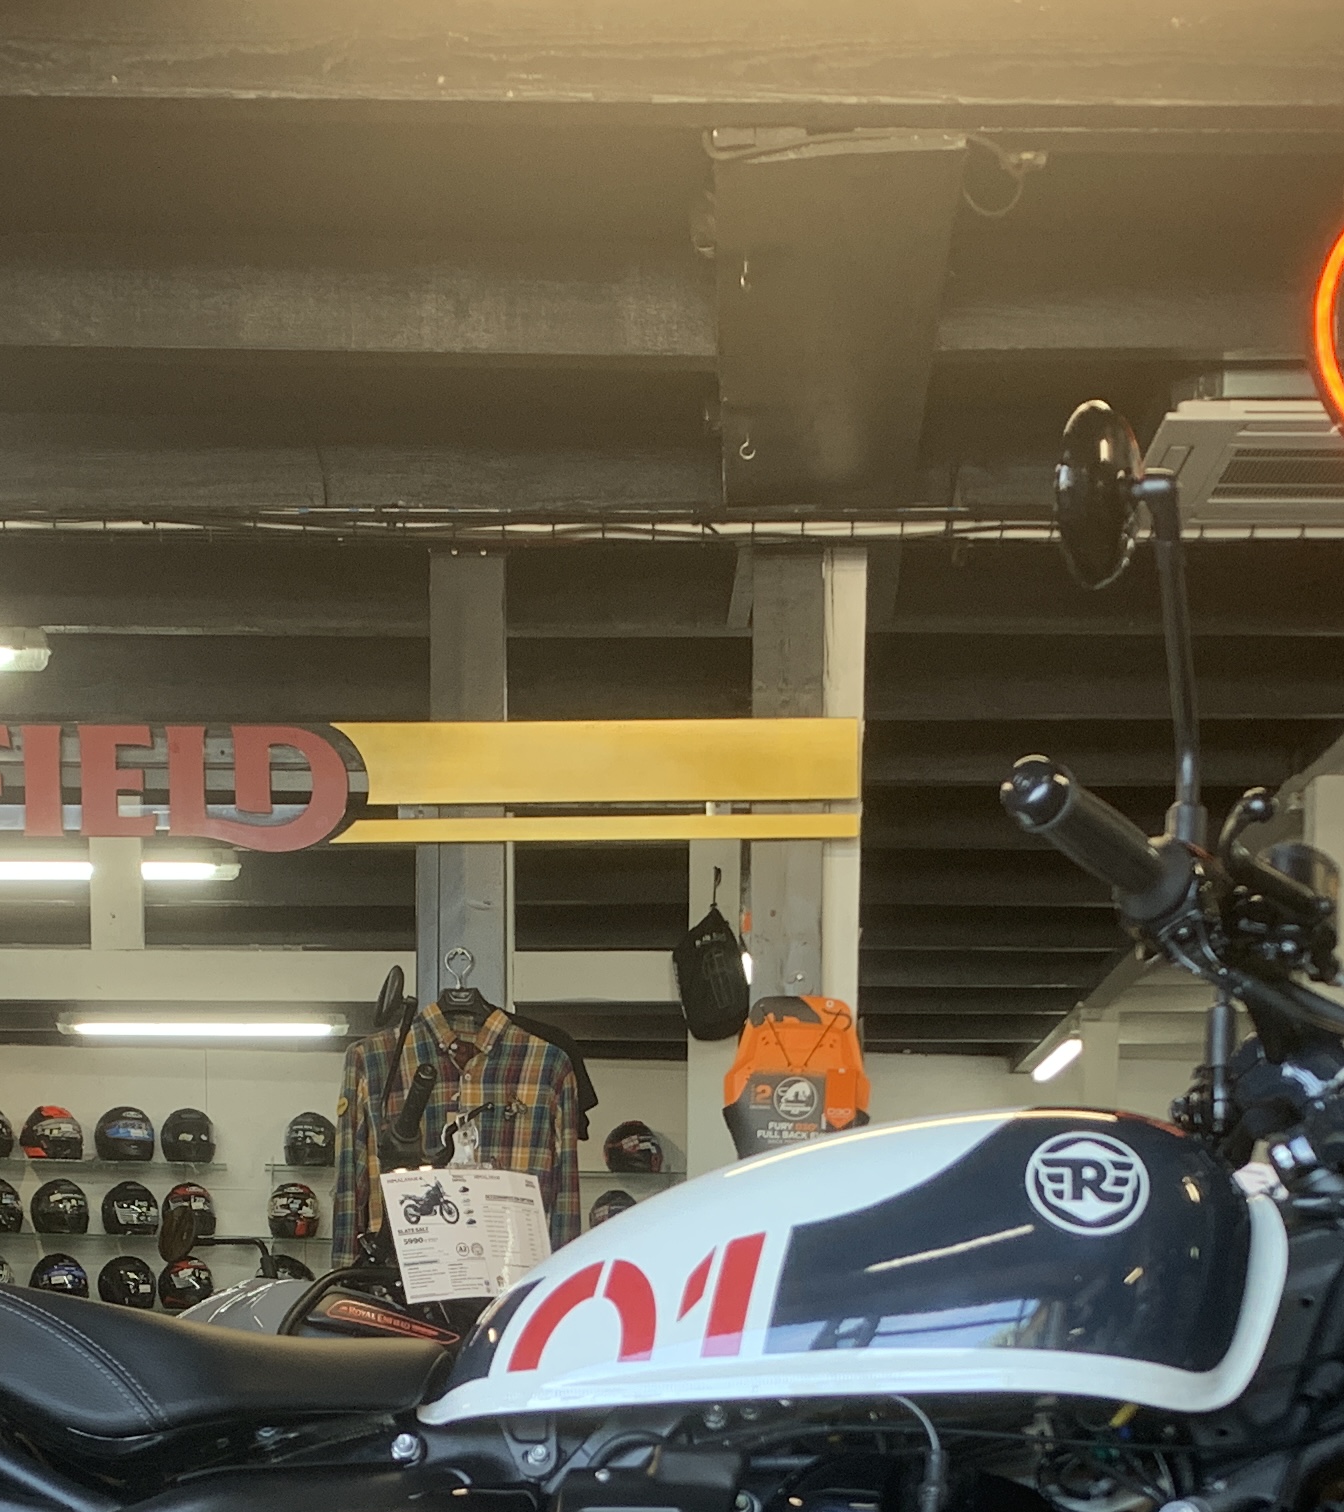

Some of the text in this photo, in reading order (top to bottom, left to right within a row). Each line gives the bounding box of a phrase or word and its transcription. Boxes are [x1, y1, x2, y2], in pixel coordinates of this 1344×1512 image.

[768, 1121, 794, 1131] FURY
[757, 1130, 781, 1139] FULL
[782, 1130, 807, 1139] BACK
